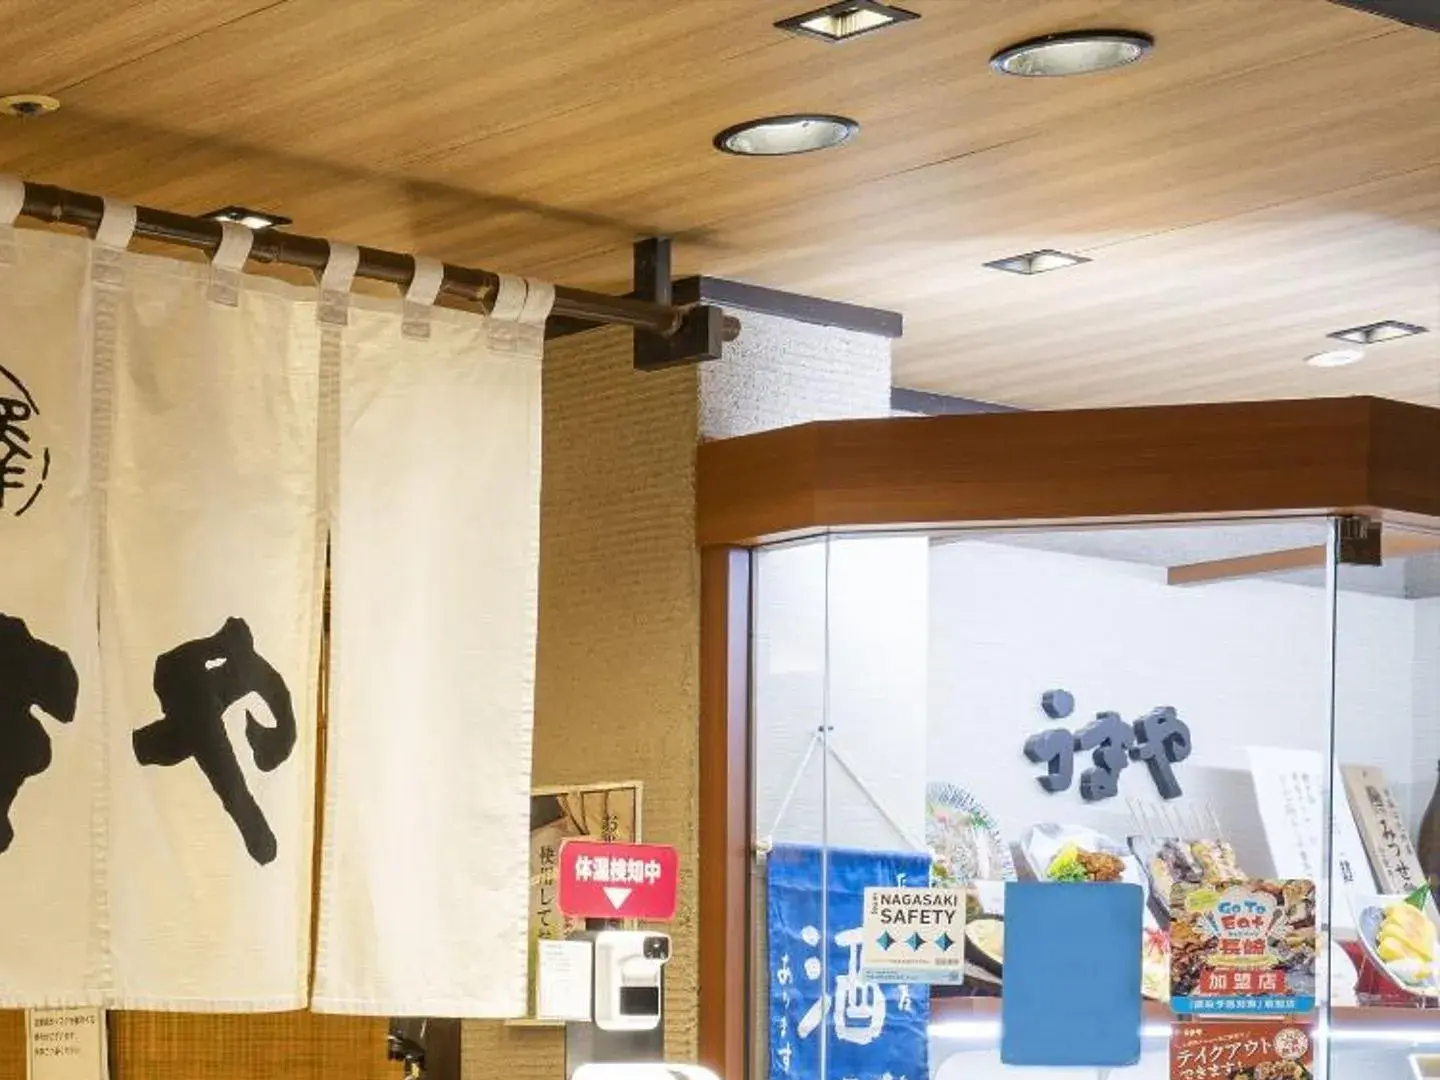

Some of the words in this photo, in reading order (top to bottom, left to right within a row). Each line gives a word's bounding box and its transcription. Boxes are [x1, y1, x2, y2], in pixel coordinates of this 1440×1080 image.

[1023, 688, 1192, 800] うまや
[574, 855, 662, 885] 体温検知中
[880, 894, 958, 907] NAGASAKI
[1218, 901, 1241, 914] Go
[1244, 901, 1266, 914] To
[880, 908, 957, 925] SAFETY
[1220, 915, 1264, 930] Eat
[1219, 938, 1266, 955] 長崎
[797, 925, 886, 1045] 酒
[1208, 972, 1278, 990] 加盟店
[776, 953, 794, 1073] あります
[1176, 1037, 1273, 1068] テイクアウト
